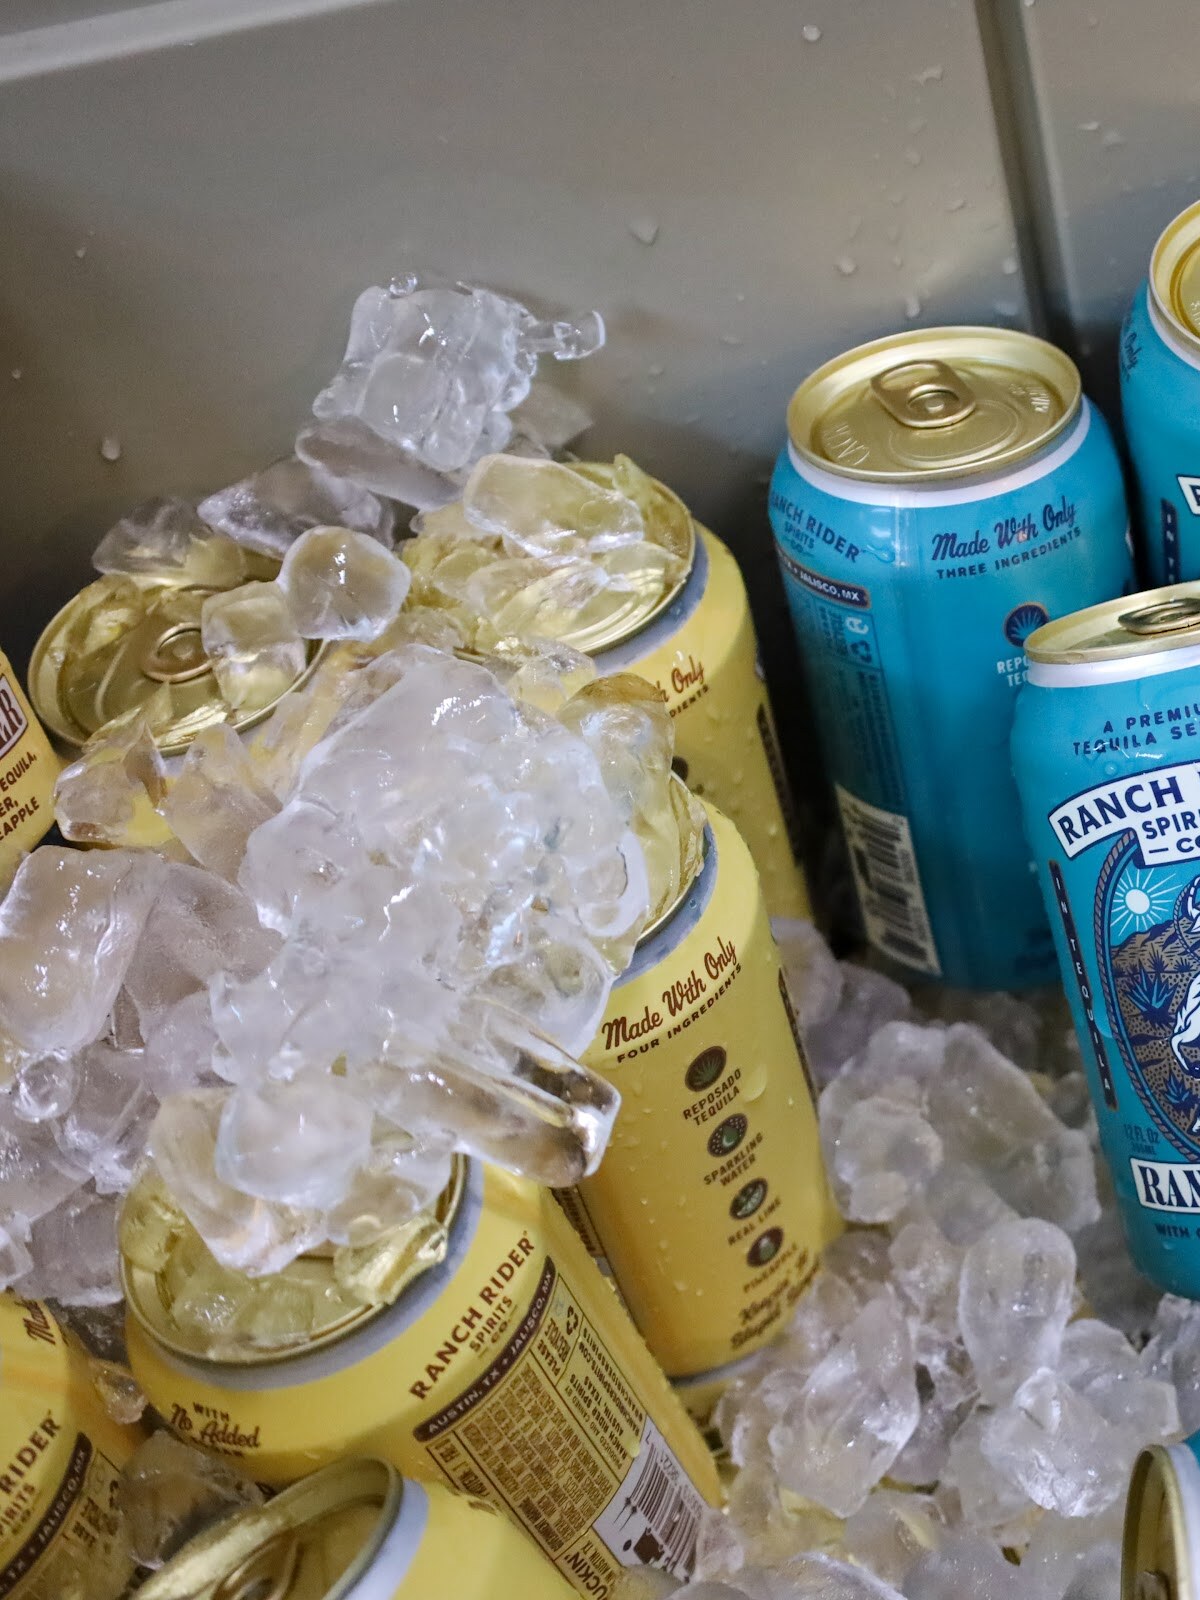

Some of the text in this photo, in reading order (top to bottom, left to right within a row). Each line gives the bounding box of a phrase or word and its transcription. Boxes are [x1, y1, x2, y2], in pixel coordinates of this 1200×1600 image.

[806, 515, 862, 564] RIDER
[931, 495, 1077, 562] Made With Only
[936, 526, 1082, 580] THREE INGREDIENTS
[669, 683, 710, 718] DIENTS
[671, 655, 705, 694] Only
[1072, 731, 1157, 756] TEQUILA
[1102, 720, 1114, 734] A
[0, 751, 37, 793] EQUILA,
[1056, 776, 1185, 846] RANCH
[601, 936, 738, 1051] Made With Only
[616, 963, 743, 1064] FOUR INGREDIENTS
[1069, 937, 1111, 1091] TEQUILA
[682, 1067, 743, 1121] REPOSADO
[693, 1085, 741, 1127] TEQUILA
[702, 1132, 764, 1186] SPARKLING
[720, 1153, 757, 1188] WATER
[728, 1197, 783, 1247] REAL LIME
[1155, 1221, 1190, 1241] WITH
[742, 1241, 800, 1293] PINEAPPLE
[408, 1235, 536, 1401] RANCH RIDER
[469, 1295, 513, 1354] SPIRITS
[543, 1317, 571, 1362] RECYCLE
[427, 1270, 554, 1435] AUSTIN, TX JALISCO, MX
[535, 1338, 561, 1376] PLEASE
[171, 1402, 193, 1430] No
[200, 1421, 261, 1449] Added
[192, 1402, 230, 1422] WITH
[563, 1385, 623, 1469] PRODUCED AND CANNED BY
[567, 1373, 628, 1459] RANCH RIDER SPIRITS
[581, 1375, 624, 1436] AUSTIN, TEXAS
[0, 1416, 61, 1497] RIDER
[563, 1549, 609, 1600] UCKIN'
